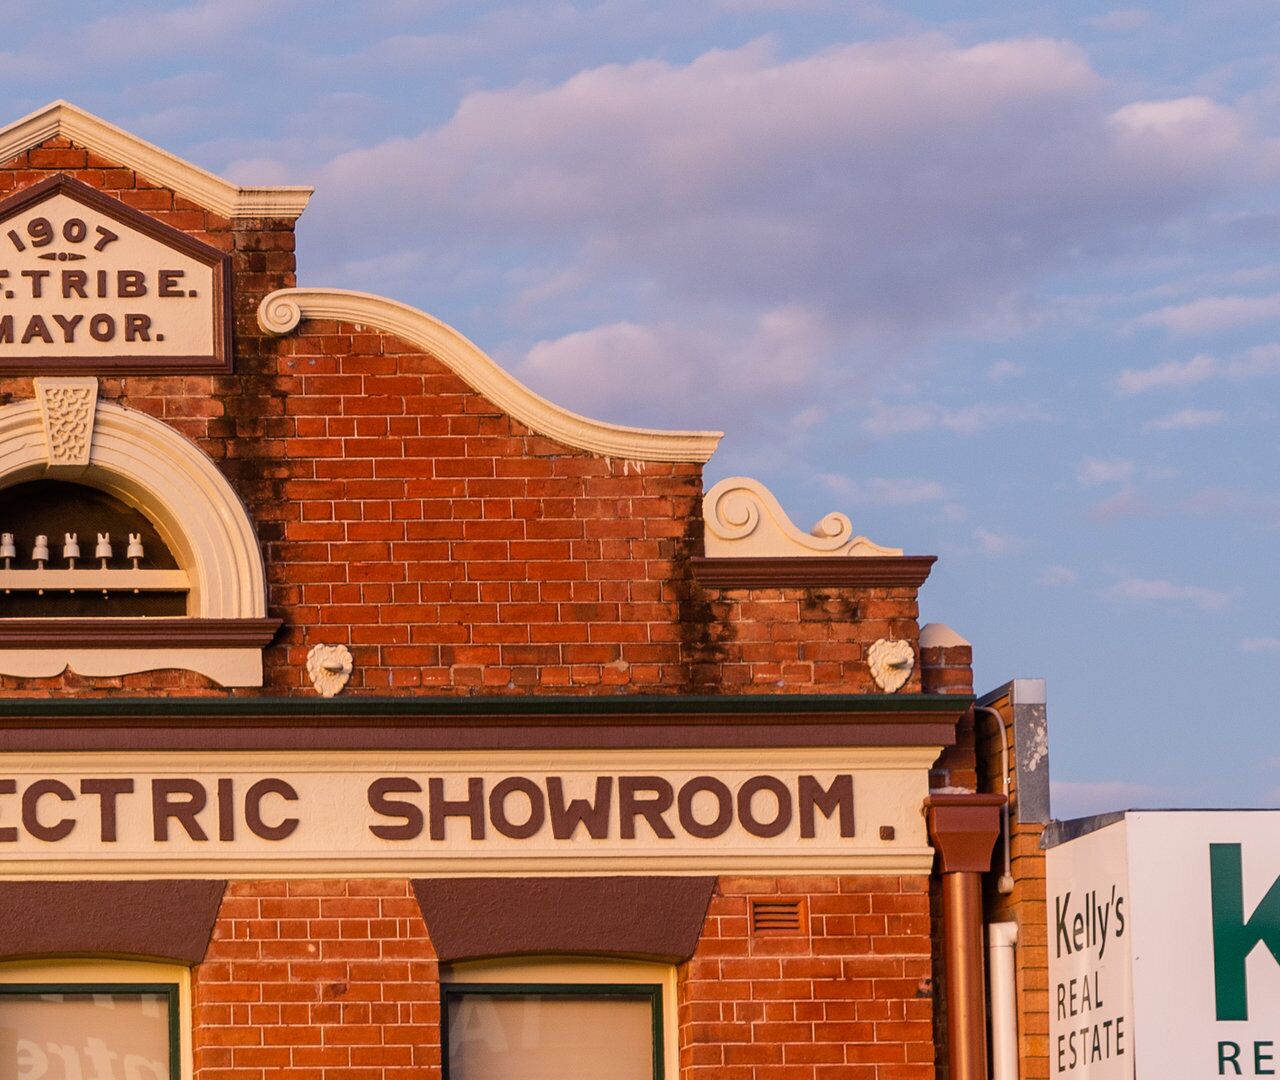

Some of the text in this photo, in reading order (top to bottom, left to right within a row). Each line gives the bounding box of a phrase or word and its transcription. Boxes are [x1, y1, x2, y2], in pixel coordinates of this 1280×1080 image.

[6, 217, 119, 252] 1907
[367, 774, 896, 840] SHOWROOM.
[1054, 884, 1125, 959] Kelly's
[1209, 842, 1280, 1021] K
[1057, 971, 1103, 1021] REAL
[1057, 1017, 1125, 1073] ESTATE
[1217, 1041, 1275, 1075] RE
